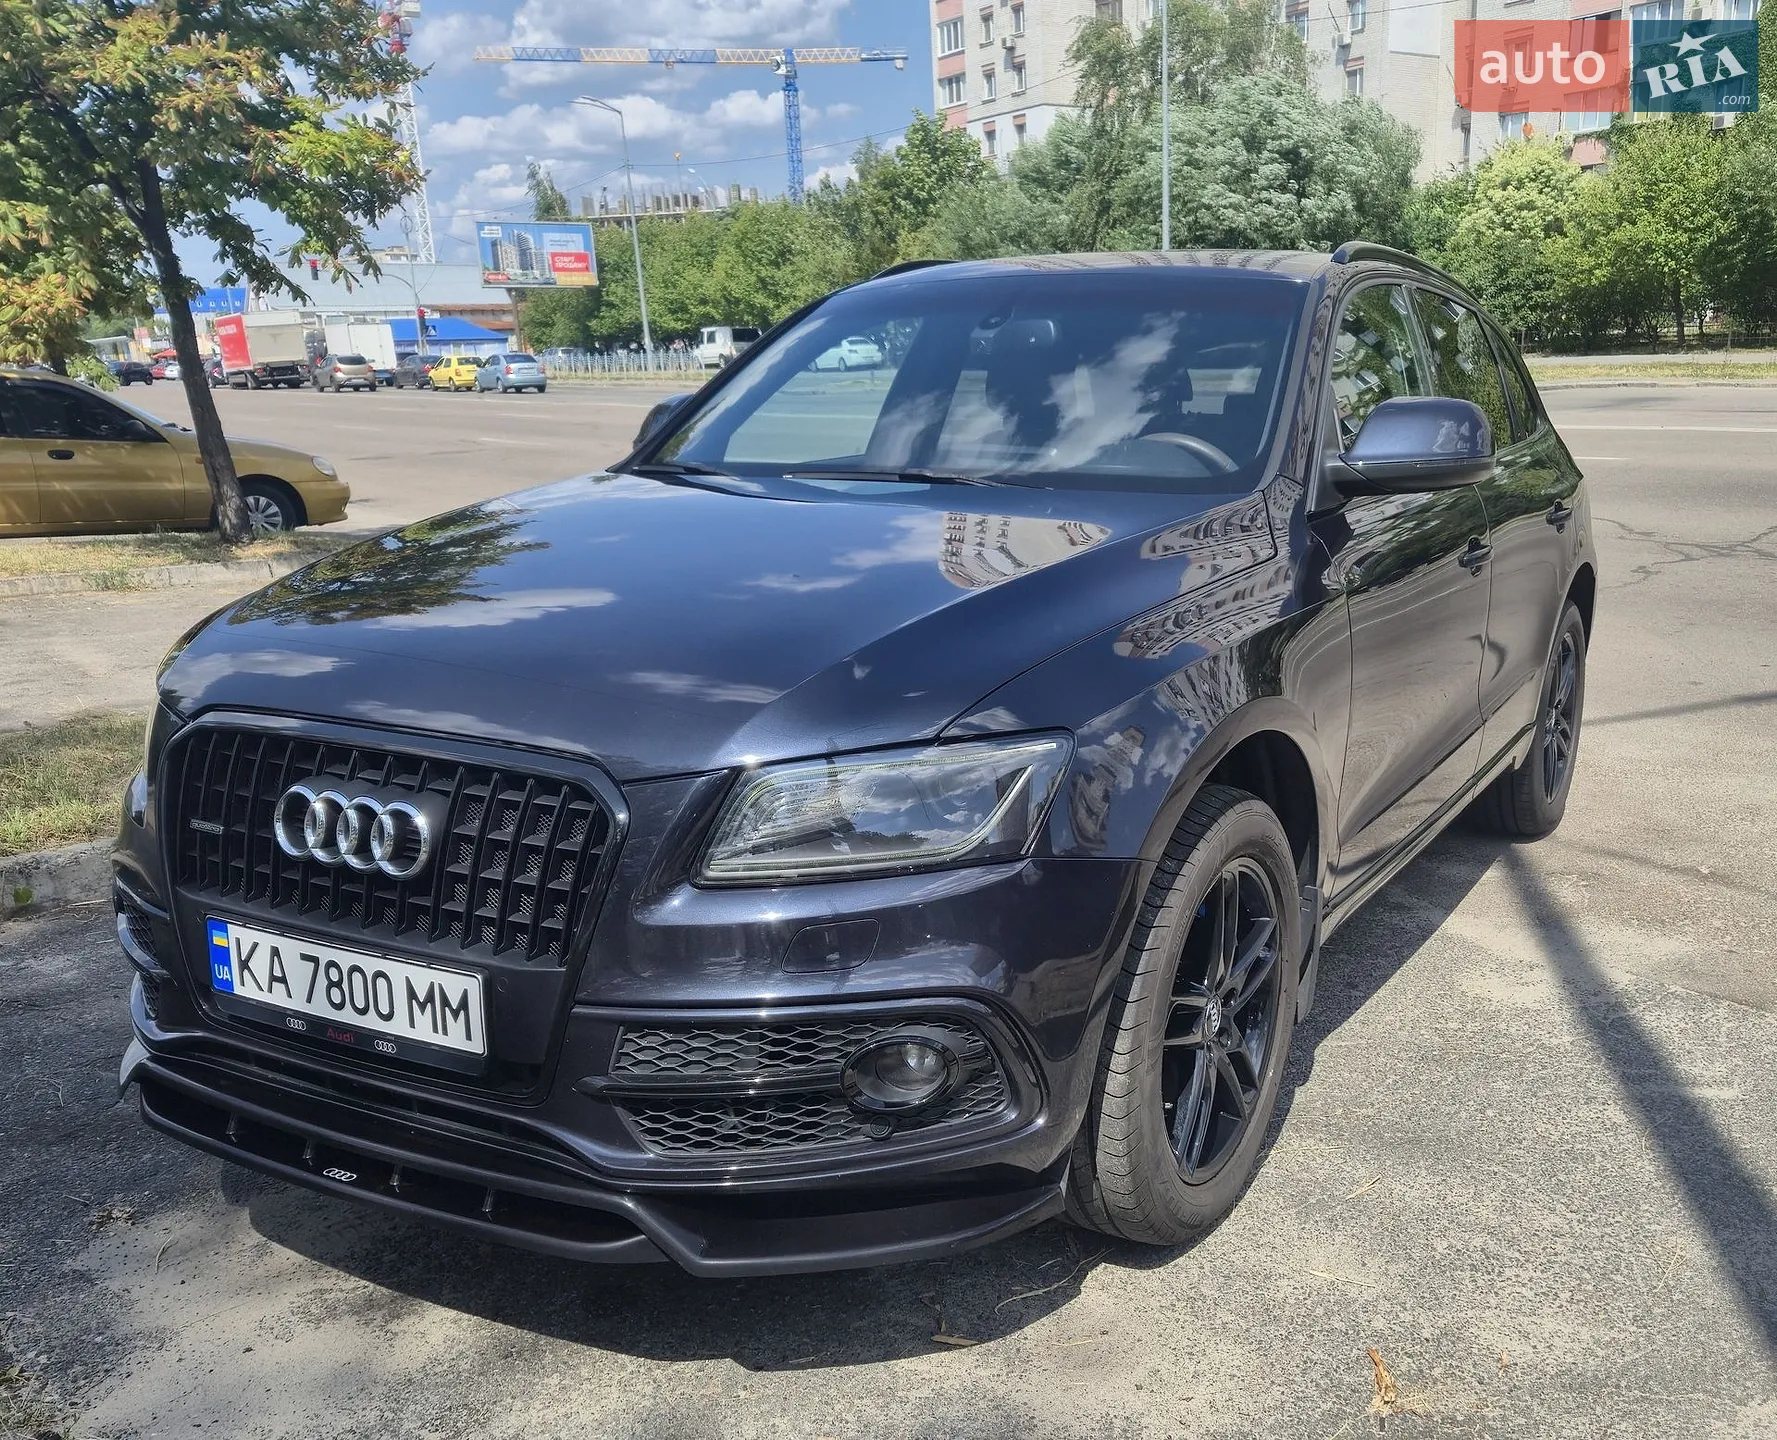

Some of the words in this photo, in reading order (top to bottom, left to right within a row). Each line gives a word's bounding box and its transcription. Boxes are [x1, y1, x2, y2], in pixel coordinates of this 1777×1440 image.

[215, 963, 232, 982] UA
[235, 937, 293, 999] KA
[299, 951, 395, 1022] 7800
[405, 975, 473, 1042] MM
[327, 1027, 354, 1044] Audi
